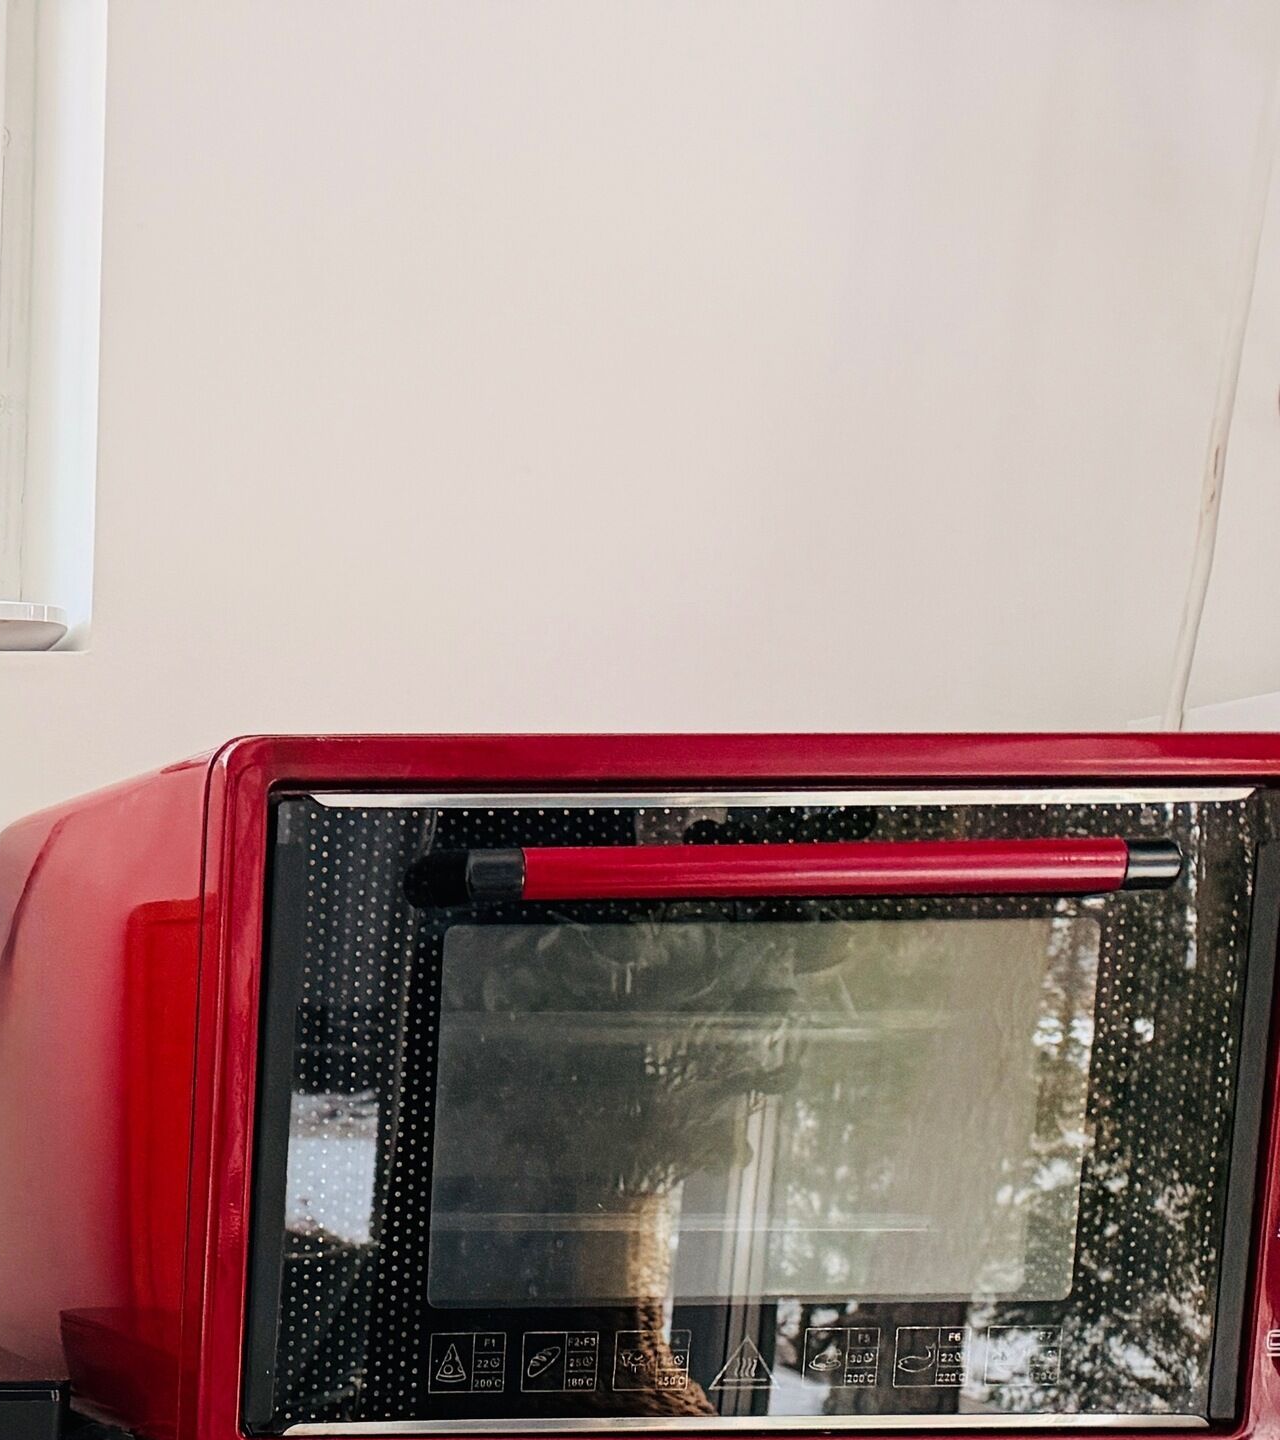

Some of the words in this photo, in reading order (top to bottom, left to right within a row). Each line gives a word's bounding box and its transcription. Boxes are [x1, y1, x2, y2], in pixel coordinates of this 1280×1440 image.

[948, 1332, 961, 1342] F6
[484, 1338, 496, 1348] F1
[940, 1353, 953, 1362] 22
[476, 1359, 489, 1369] 22
